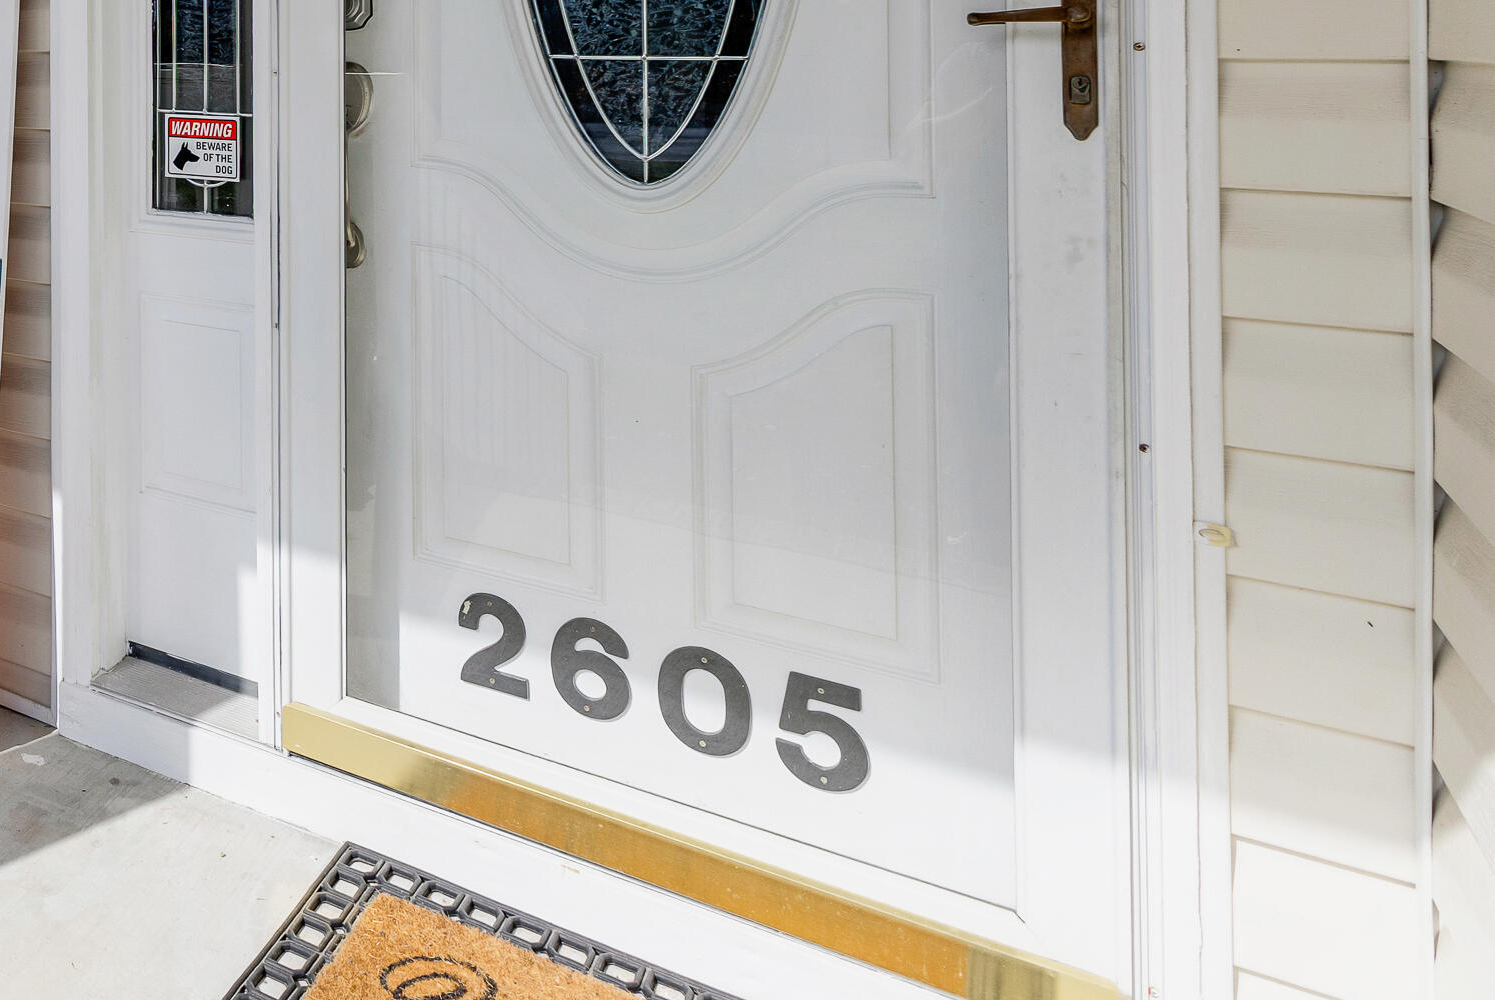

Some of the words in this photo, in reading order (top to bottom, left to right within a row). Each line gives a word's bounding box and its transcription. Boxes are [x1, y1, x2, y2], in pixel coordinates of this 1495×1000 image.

[171, 120, 233, 138] WARNING
[196, 141, 233, 152] BEWARE
[203, 152, 215, 162] OF
[215, 153, 233, 164] THE
[215, 165, 233, 175] DOG
[458, 592, 871, 793] 2605
